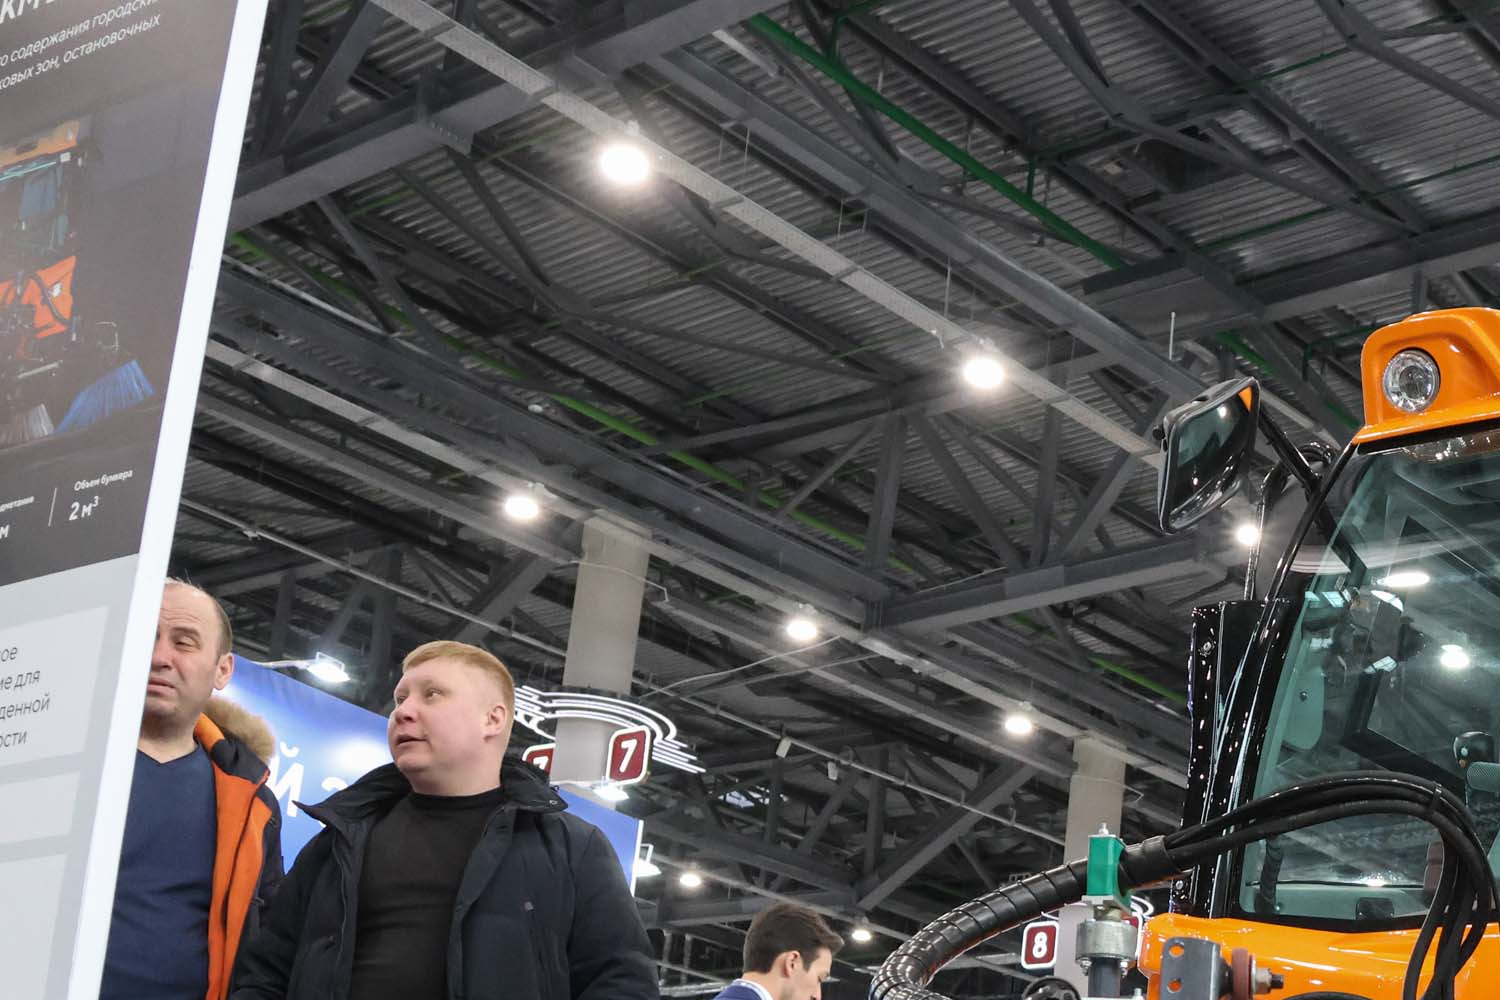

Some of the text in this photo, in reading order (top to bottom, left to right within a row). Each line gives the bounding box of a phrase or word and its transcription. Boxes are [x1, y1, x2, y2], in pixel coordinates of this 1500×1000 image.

[10, 19, 90, 62] содержания
[63, 14, 161, 63] остановочных
[69, 502, 80, 520] 2
[14, 670, 41, 692] для
[619, 739, 638, 773] 7
[1032, 931, 1048, 959] 8
